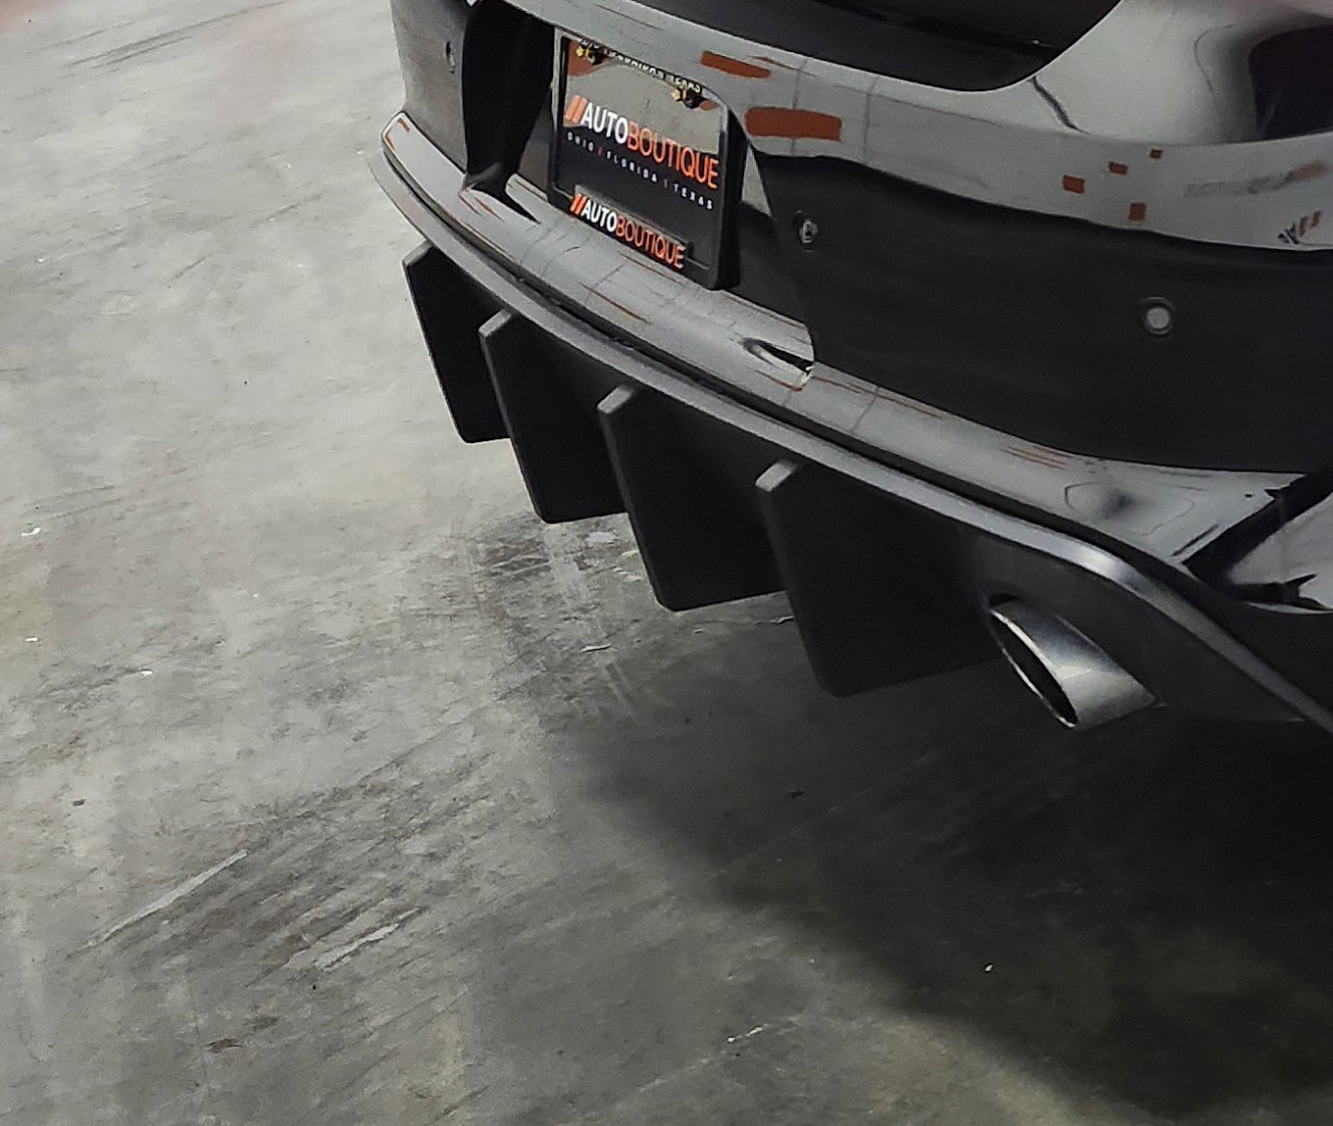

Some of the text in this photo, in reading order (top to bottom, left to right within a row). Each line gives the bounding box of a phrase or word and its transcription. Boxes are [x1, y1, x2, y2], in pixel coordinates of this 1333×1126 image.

[567, 131, 713, 210] OHIO FLORIDA TEXAS
